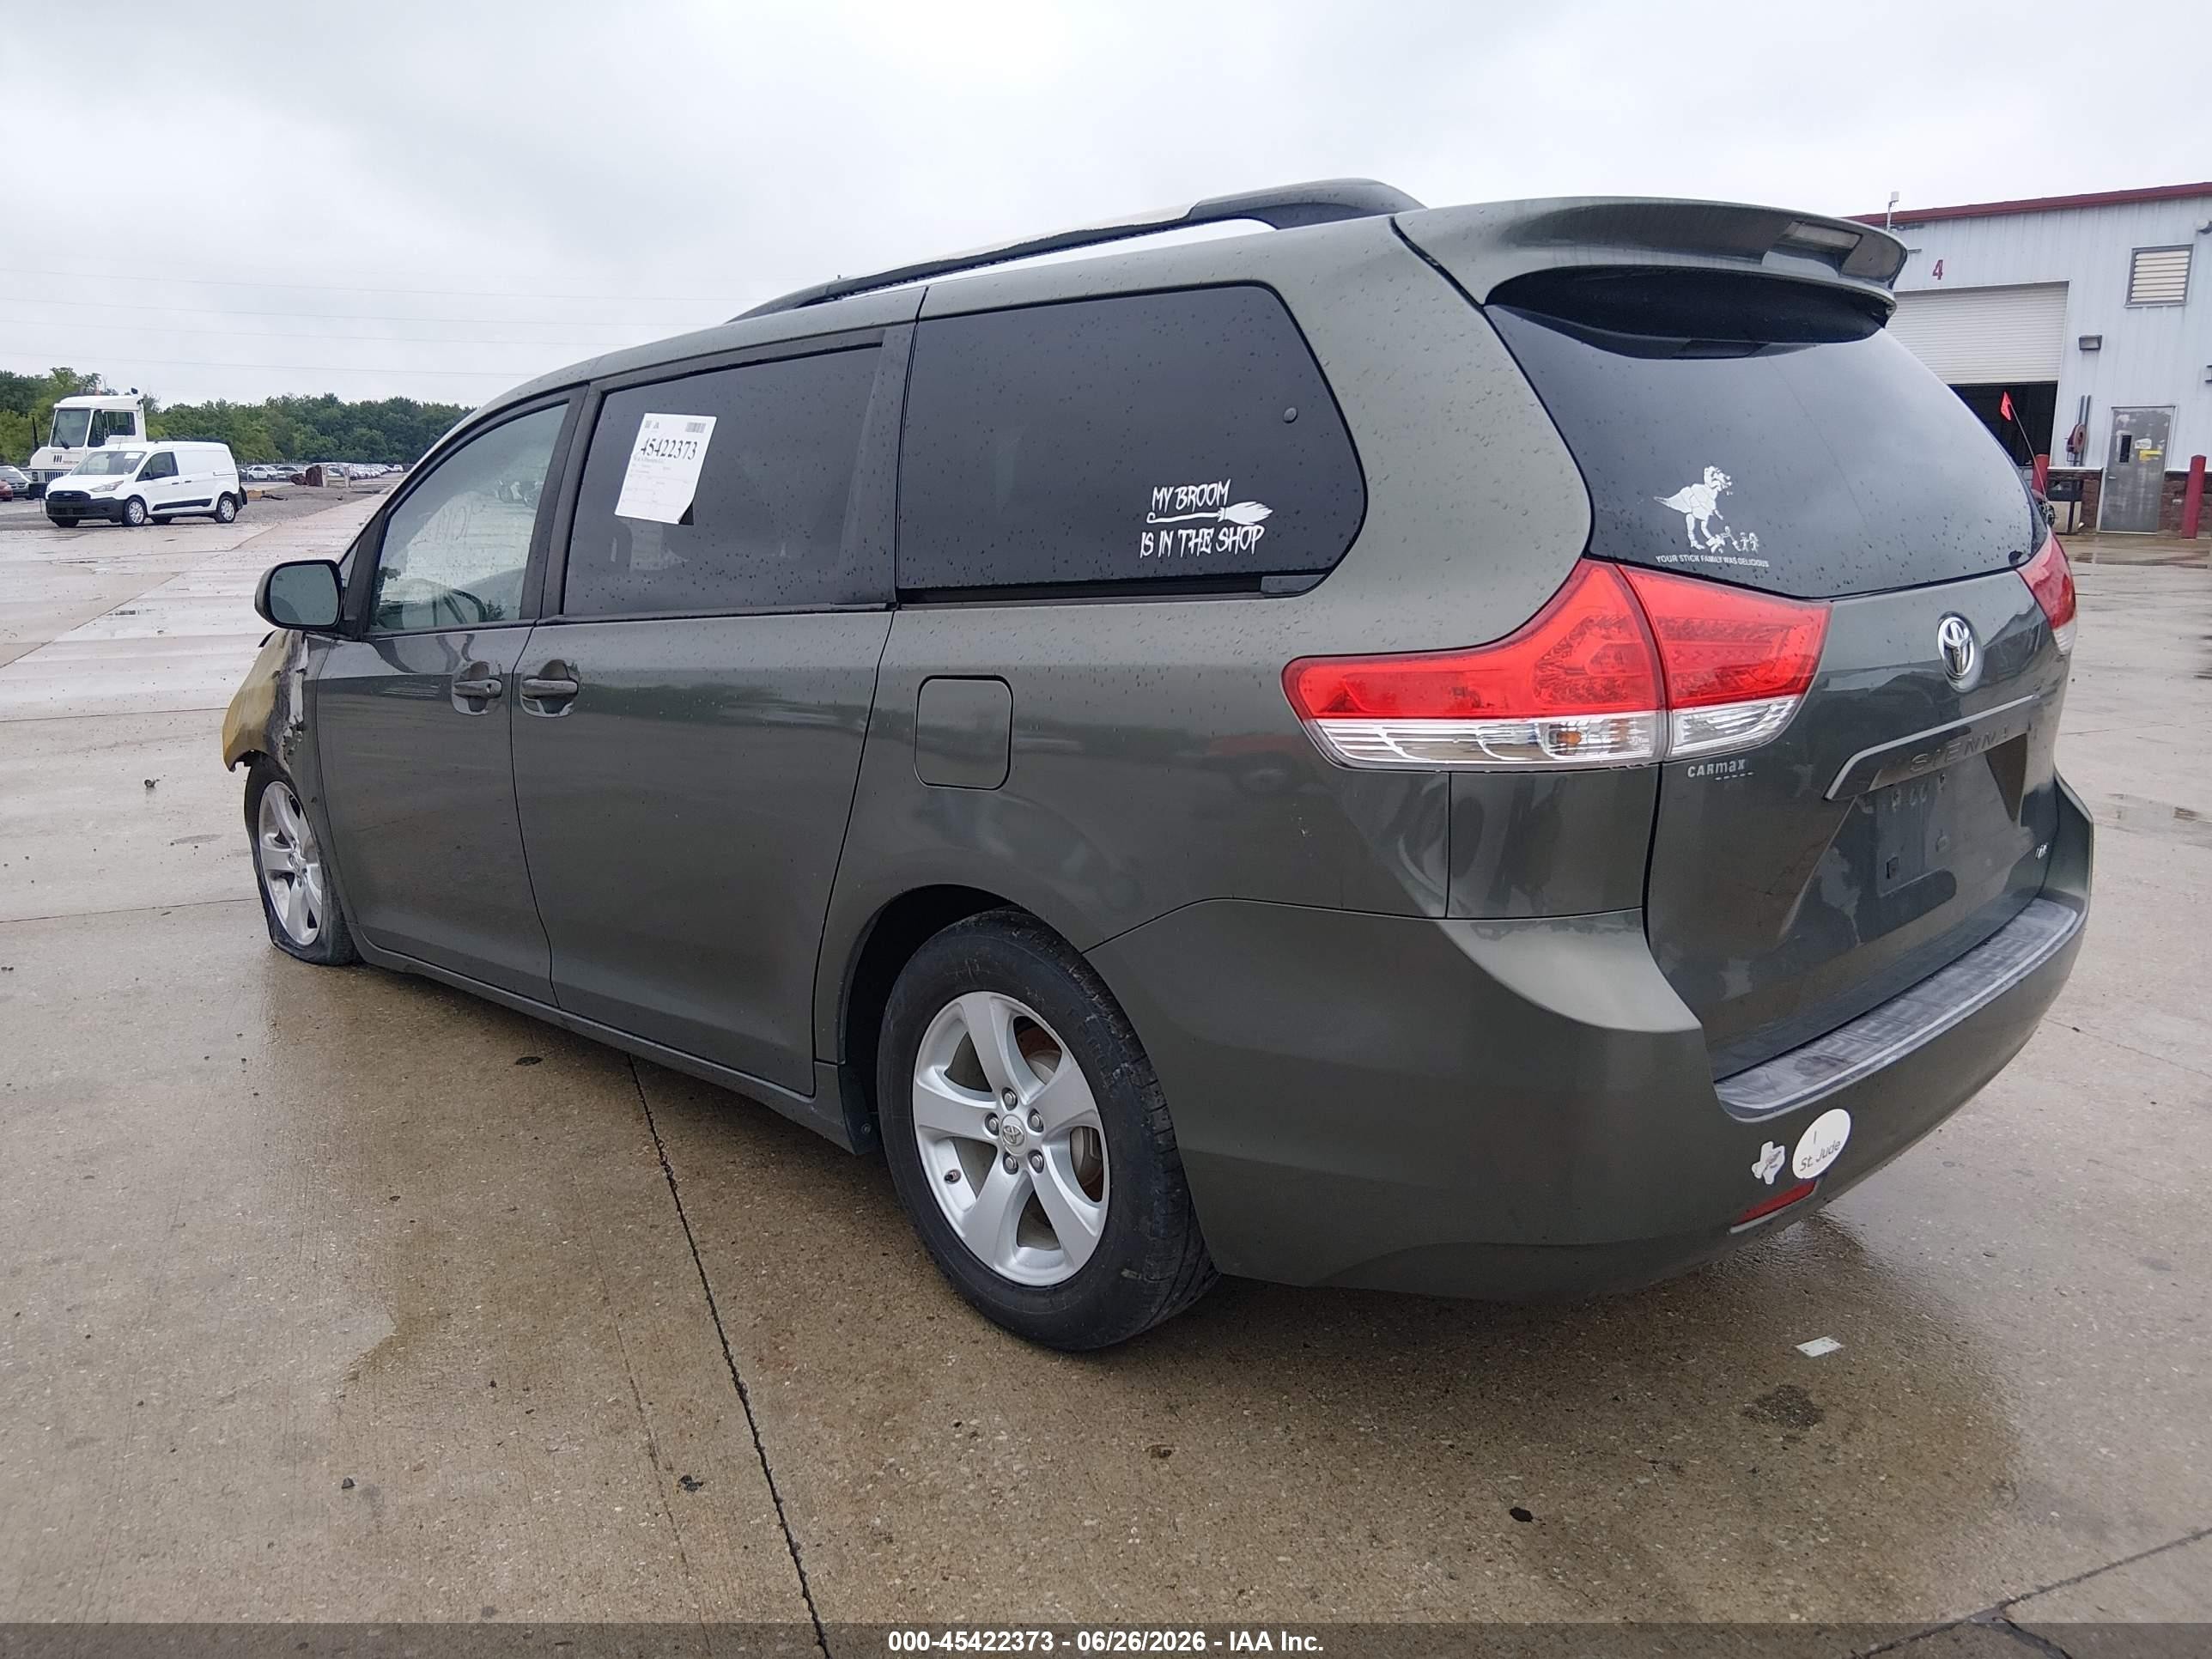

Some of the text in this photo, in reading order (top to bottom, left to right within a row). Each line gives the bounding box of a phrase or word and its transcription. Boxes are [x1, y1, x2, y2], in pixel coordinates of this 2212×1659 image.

[1932, 259, 1943, 280] 4
[640, 437, 698, 460] 45422373
[1152, 478, 1231, 514] MY BROOM
[1139, 524, 1266, 558] IS IN THE SHOP
[1656, 554, 1769, 568] YOUR STICK FAMILY WAS DELICIOUS
[1816, 1139, 1841, 1163] Jude
